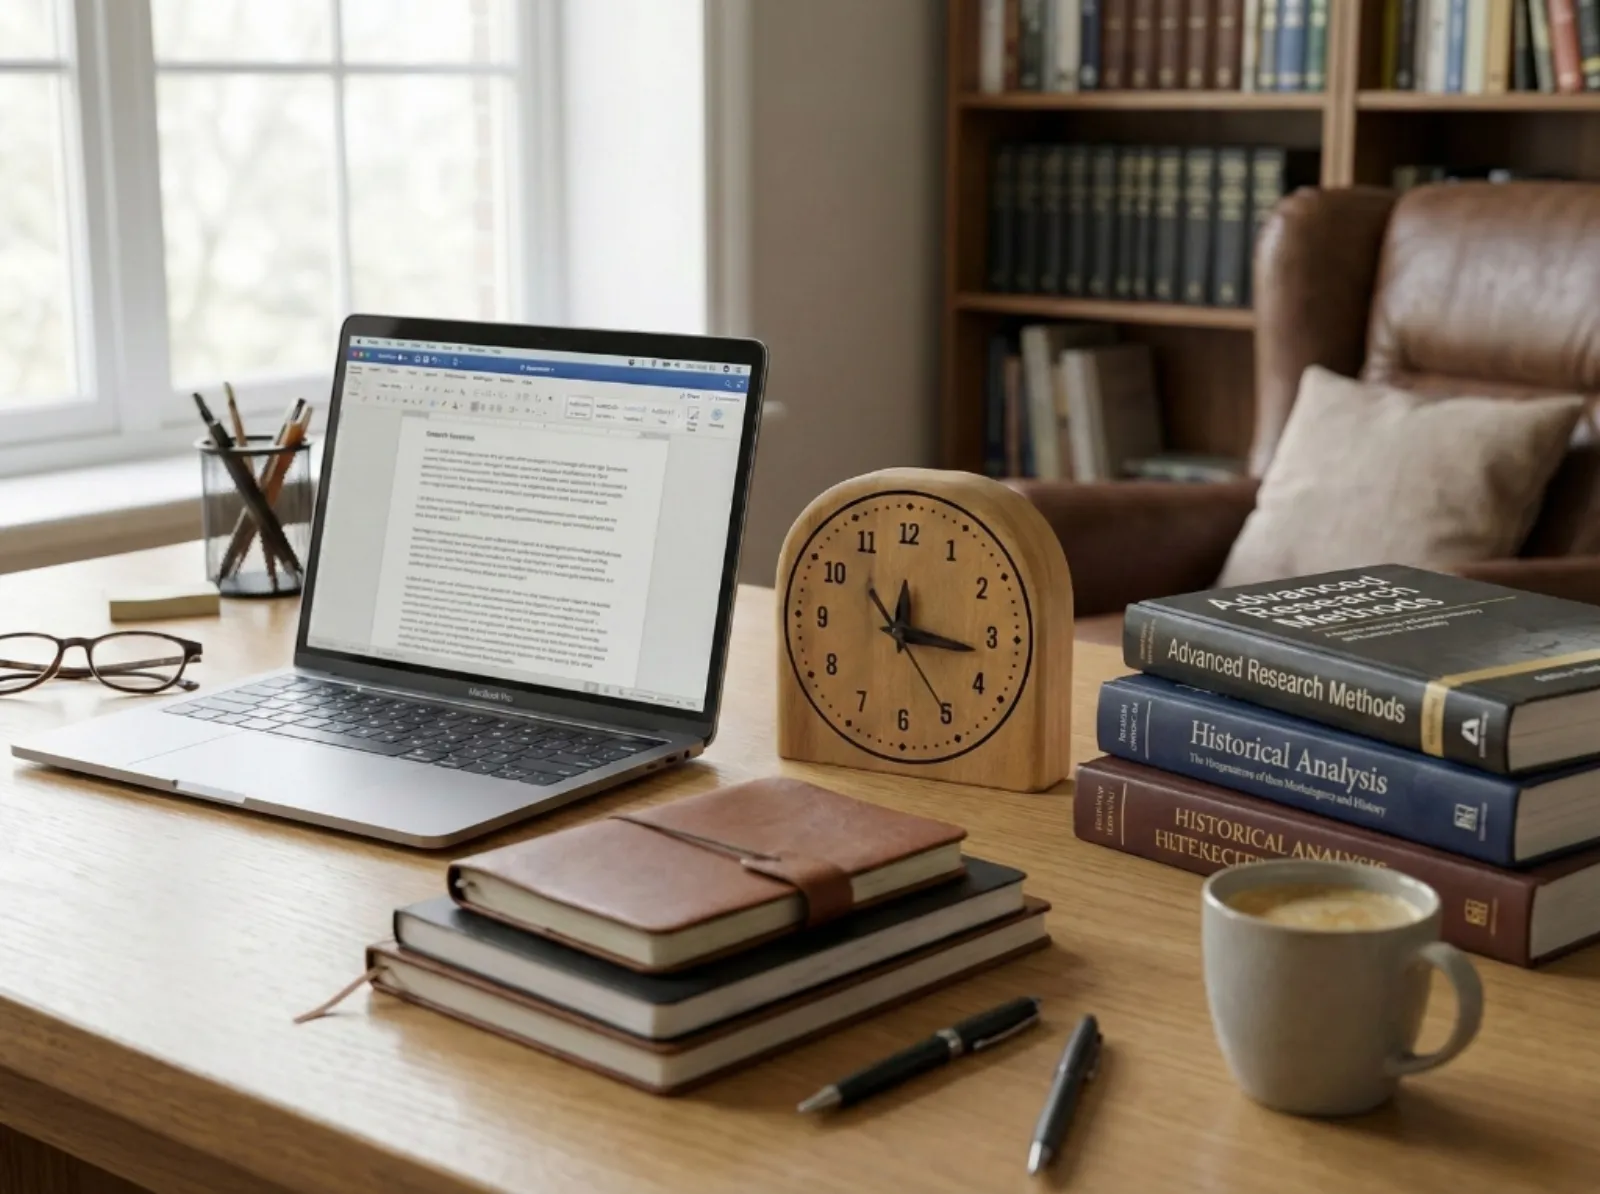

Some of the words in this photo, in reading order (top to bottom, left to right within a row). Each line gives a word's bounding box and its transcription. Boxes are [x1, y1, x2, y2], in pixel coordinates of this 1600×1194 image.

[858, 531, 876, 554] 11
[899, 523, 919, 545] 12
[946, 540, 956, 561] 1
[824, 562, 846, 584] 10
[976, 577, 988, 600] 2
[1208, 575, 1392, 611] Advanced
[1237, 586, 1420, 618] Research
[1272, 597, 1444, 629] Methods
[817, 606, 828, 628] 9
[986, 626, 998, 649] 3
[826, 653, 838, 676] 8
[972, 672, 985, 695] 4
[1167, 638, 1243, 678] Advanced
[1248, 659, 1324, 701] Research
[1329, 680, 1406, 724] Methods
[856, 690, 867, 712] 7
[897, 709, 909, 731] 6
[940, 703, 952, 725] 5
[1189, 720, 1290, 769] Historical
[1296, 749, 1388, 794] Analysis
[1175, 807, 1288, 855] HISTORICAL
